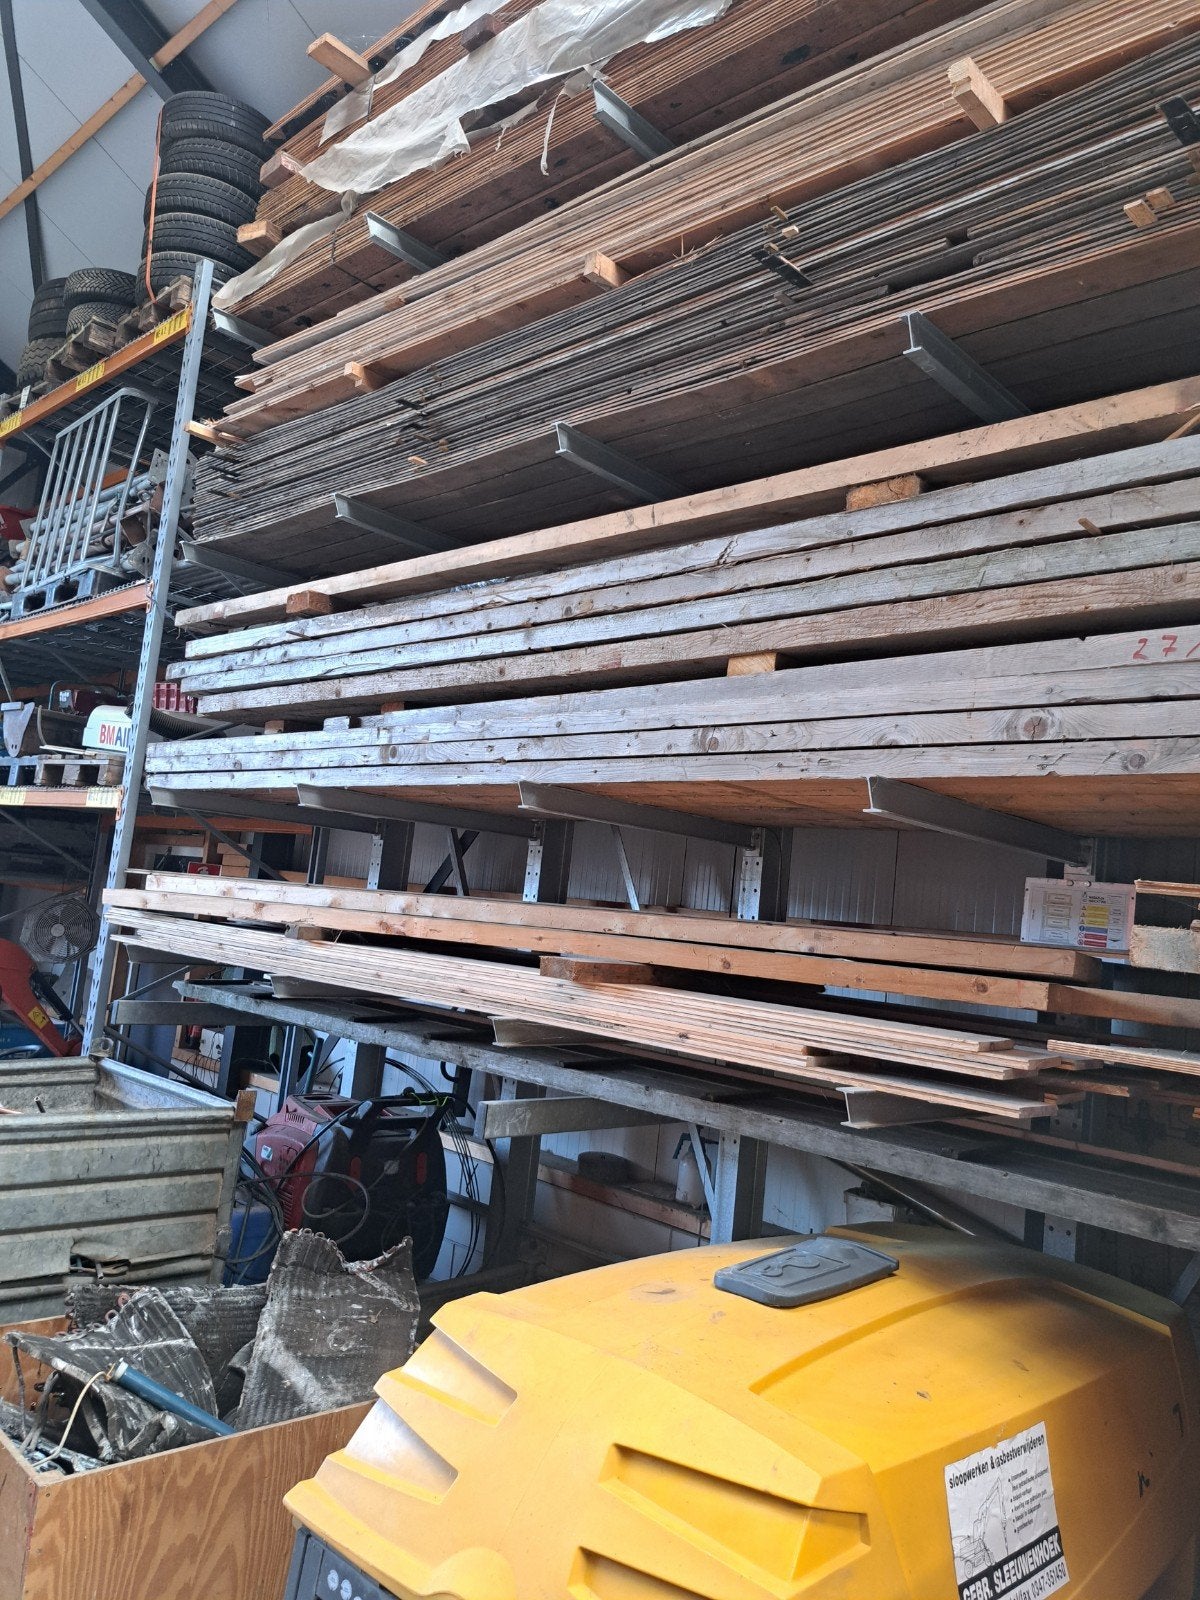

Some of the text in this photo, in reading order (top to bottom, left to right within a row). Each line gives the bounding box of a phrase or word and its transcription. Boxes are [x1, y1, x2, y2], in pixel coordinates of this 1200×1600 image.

[949, 1462, 989, 1489] sloopwerken
[990, 1455, 996, 1470] &
[995, 1434, 1045, 1468] asbestverwijderen
[993, 1533, 1062, 1594] SLEEUWENHOEK
